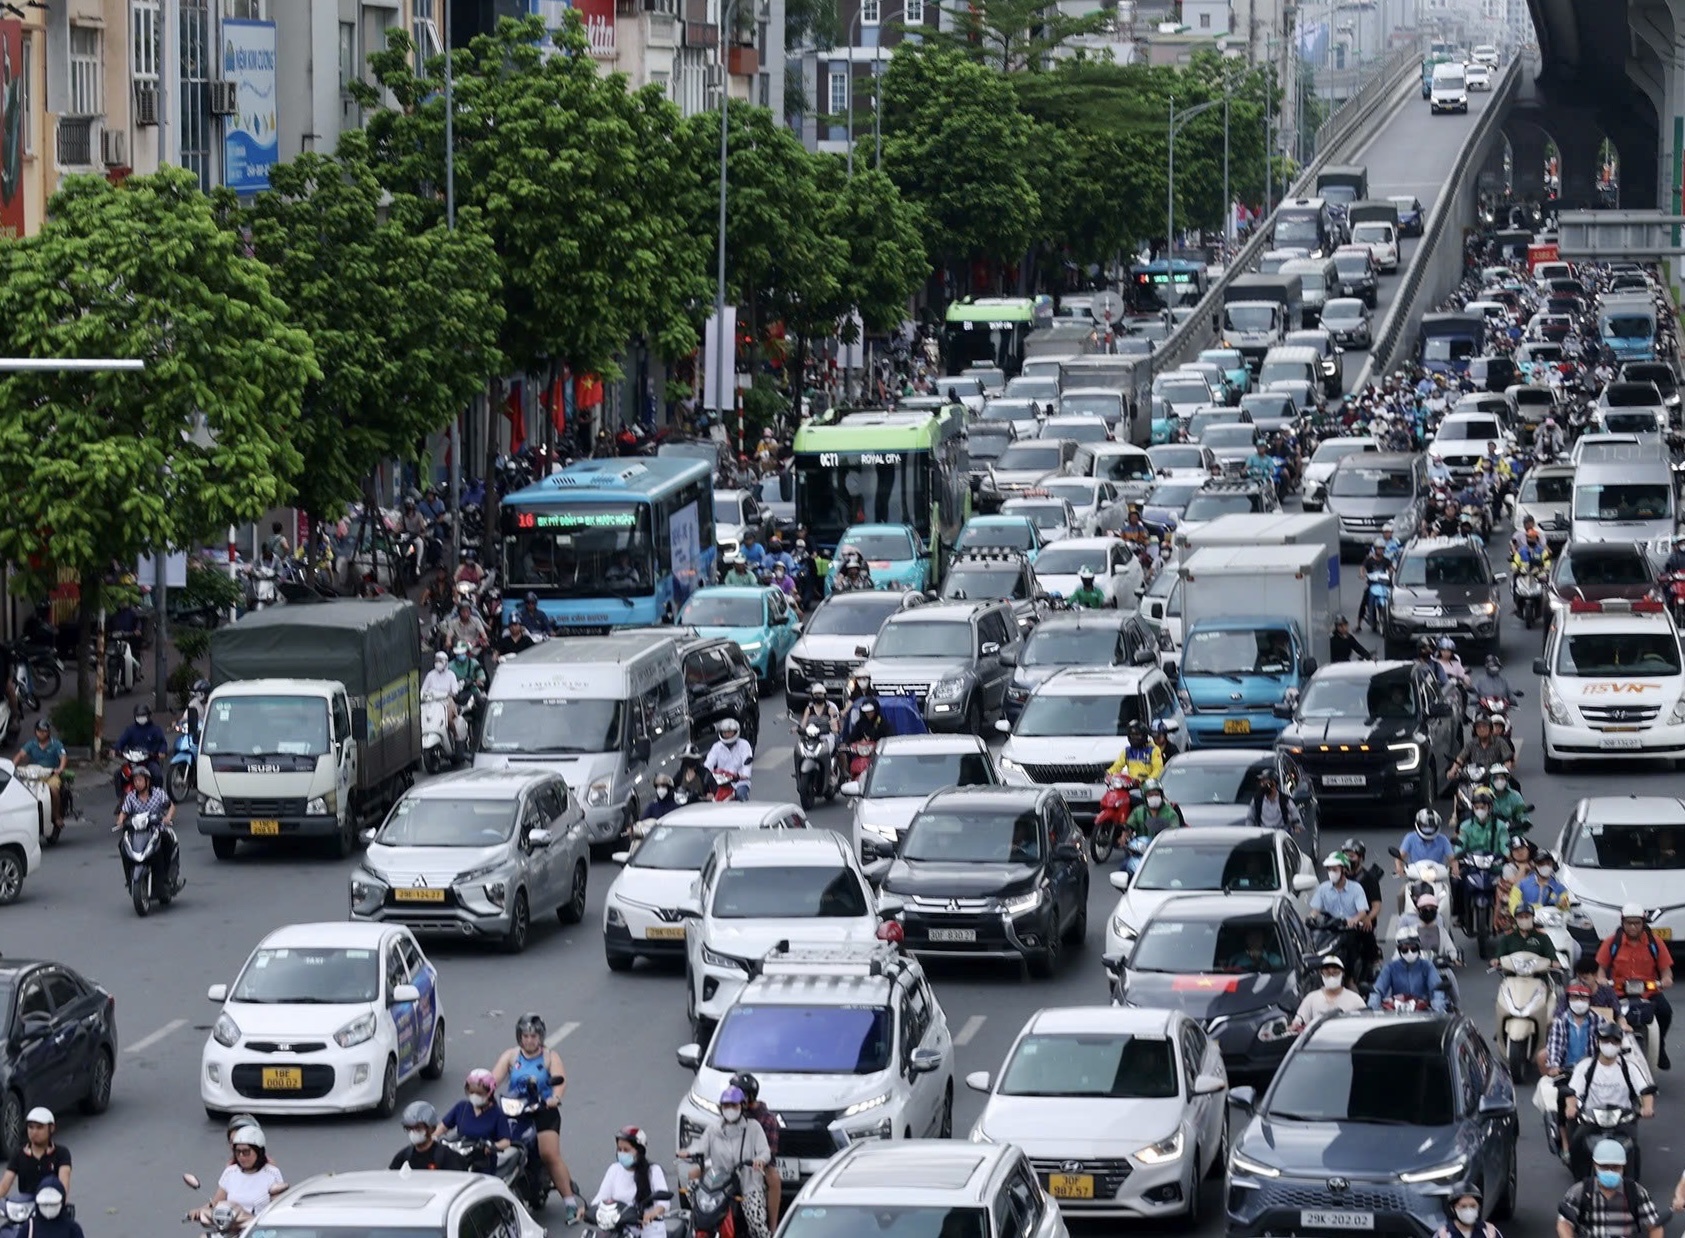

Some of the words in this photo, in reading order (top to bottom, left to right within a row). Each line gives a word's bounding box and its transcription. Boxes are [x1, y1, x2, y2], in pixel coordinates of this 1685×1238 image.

[518, 513, 534, 527] 16
[247, 764, 280, 773] ISUZU
[306, 957, 324, 965] TAXI
